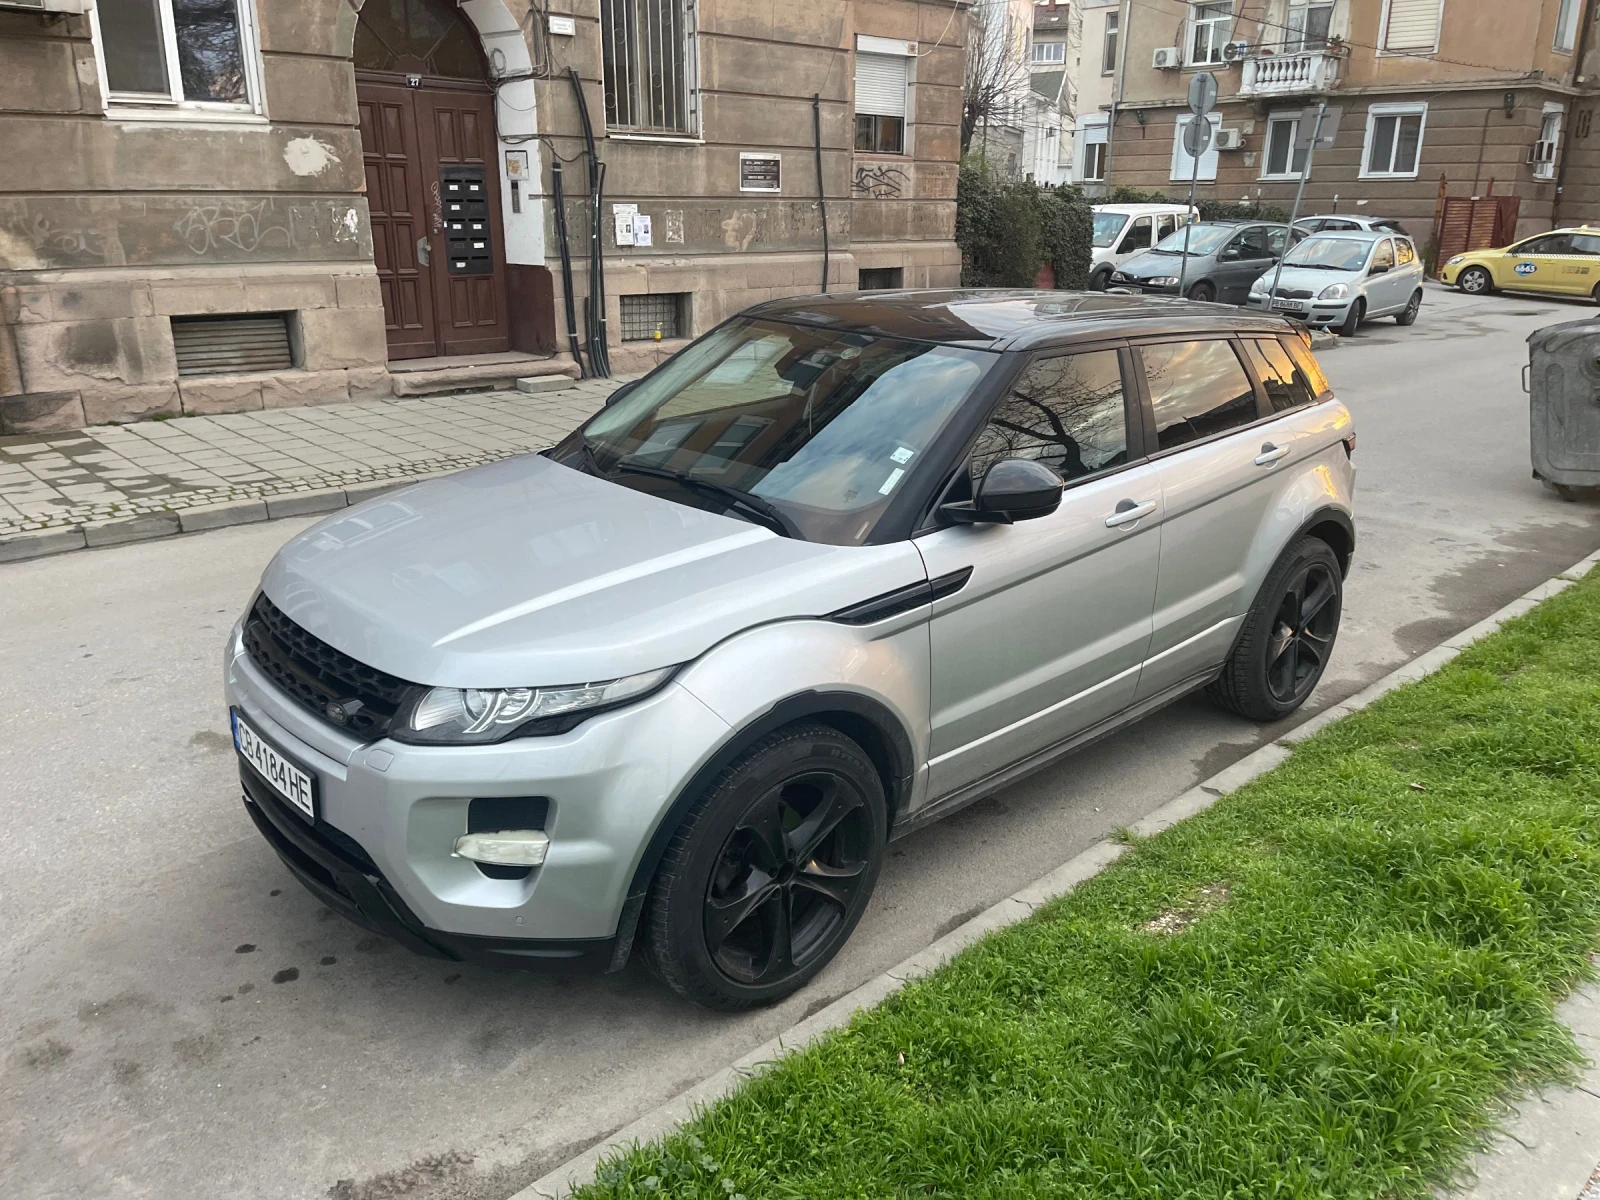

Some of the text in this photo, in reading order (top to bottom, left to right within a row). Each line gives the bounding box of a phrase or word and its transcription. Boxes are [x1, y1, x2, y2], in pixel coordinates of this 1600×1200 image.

[411, 78, 419, 86] 27
[239, 723, 310, 811] CB 4184 HE
